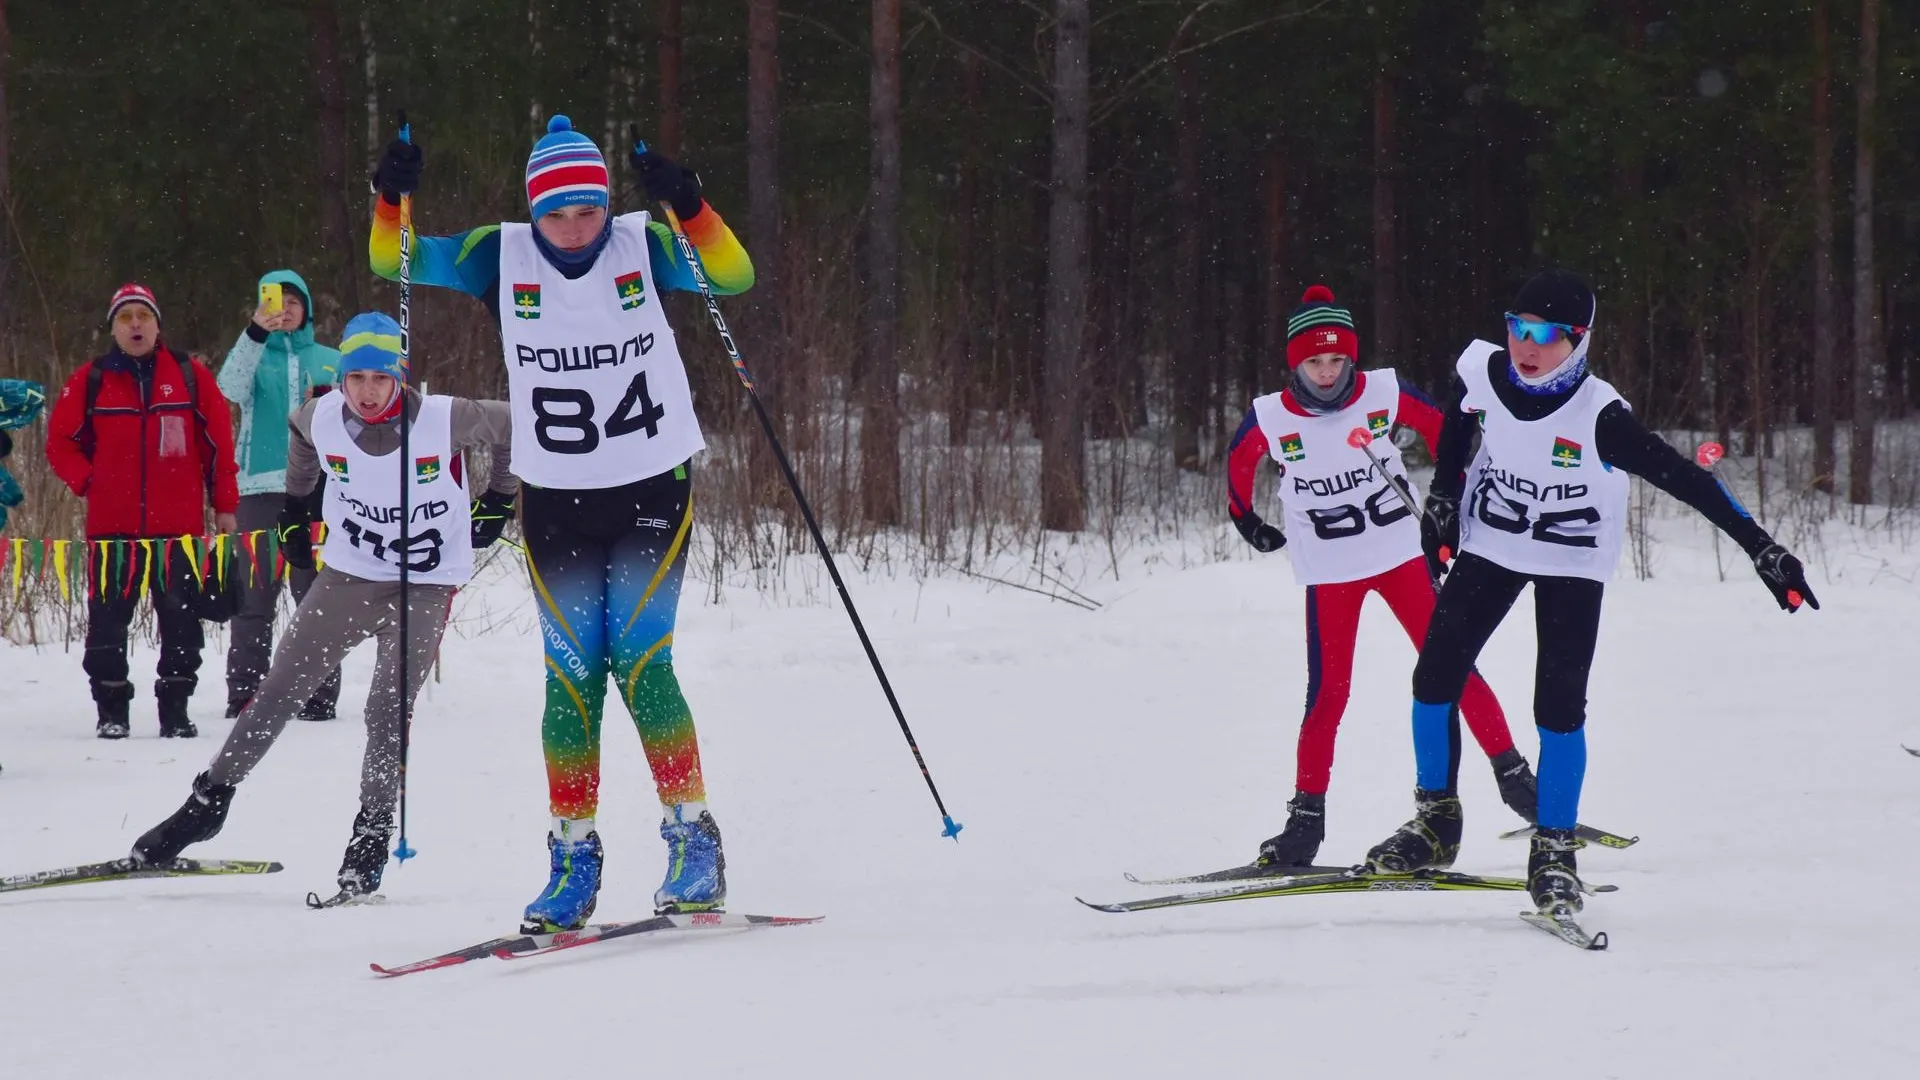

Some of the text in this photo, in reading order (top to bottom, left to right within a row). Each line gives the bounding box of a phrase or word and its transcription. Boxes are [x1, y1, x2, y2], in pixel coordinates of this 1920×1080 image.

[516, 332, 655, 373] РОШАЛЬ
[532, 370, 666, 455] 84
[1293, 455, 1393, 496] РОШАЛ
[1479, 456, 1588, 502] ШАЛЬ
[1368, 881, 1436, 891] FISCHER
[691, 913, 721, 925] ATOMIC
